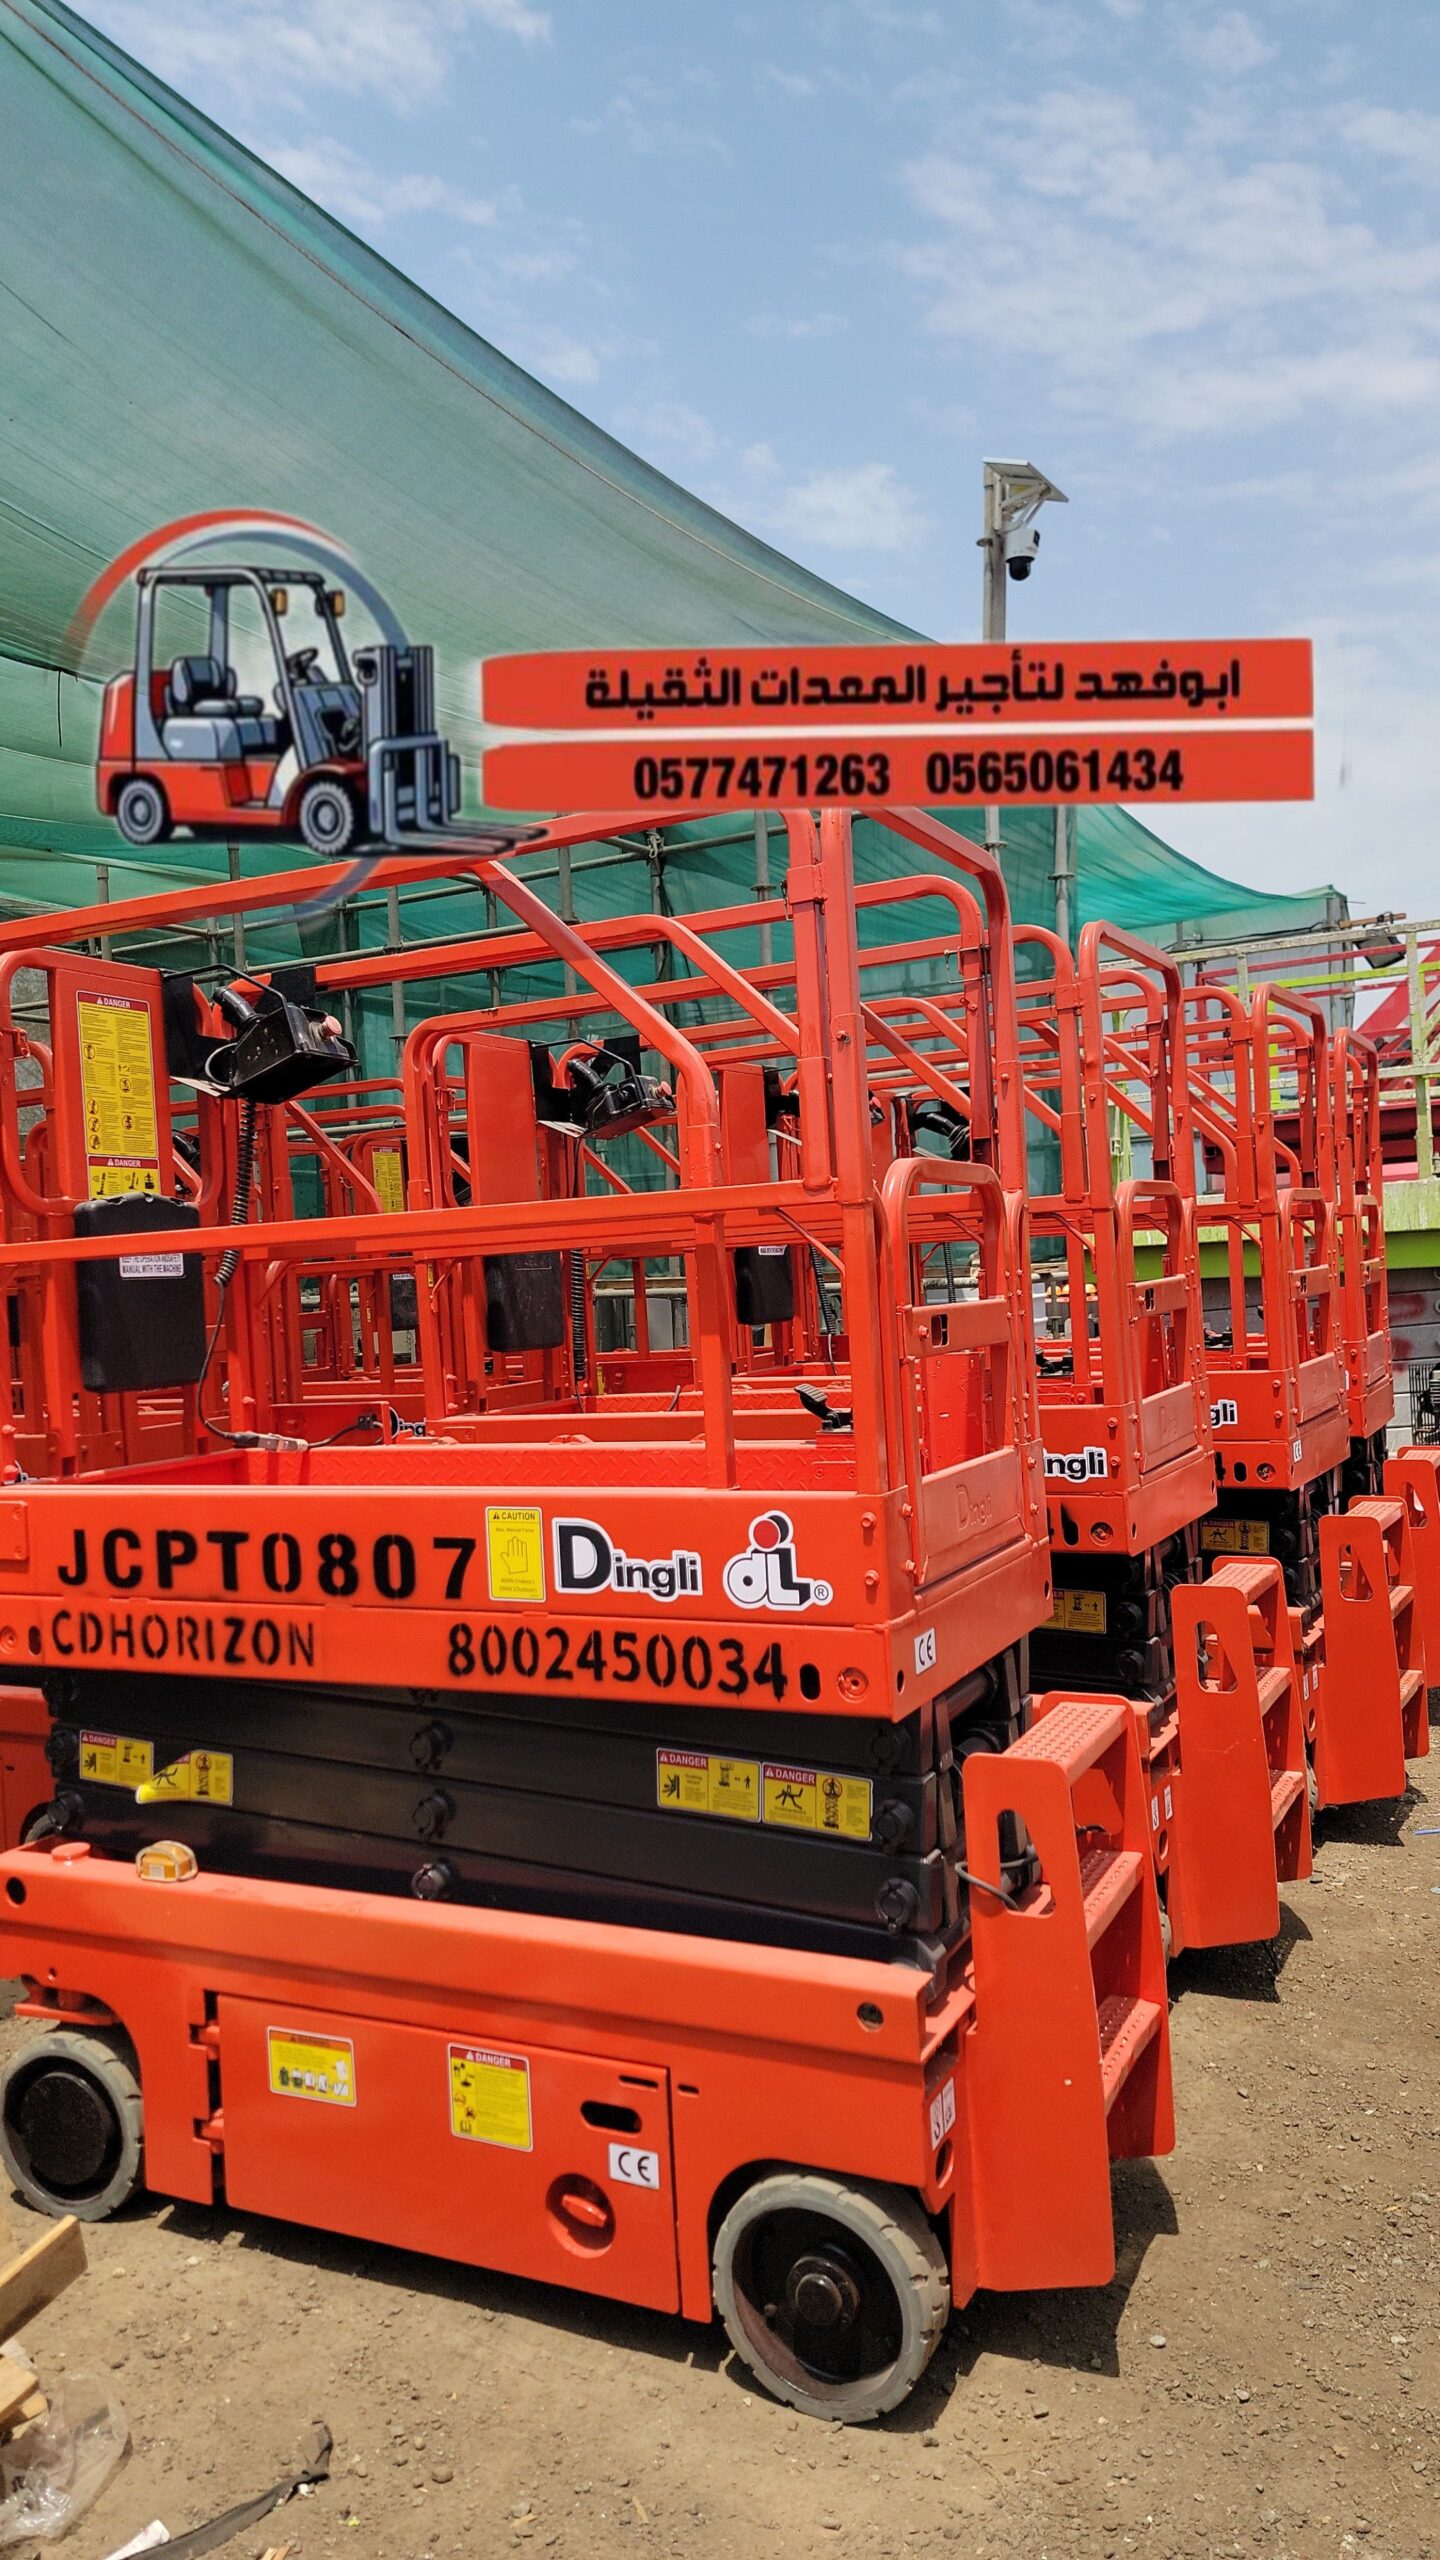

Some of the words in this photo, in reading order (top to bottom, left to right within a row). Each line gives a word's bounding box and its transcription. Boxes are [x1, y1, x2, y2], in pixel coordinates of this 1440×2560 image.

[103, 998, 131, 1008] DANGER
[114, 1159, 141, 1167] DANGER
[1045, 1450, 1105, 1480] ngli
[501, 1512, 535, 1520] CAUTION
[58, 1528, 476, 1600] JCPT0807
[556, 1521, 699, 1598] Dingli
[51, 1609, 315, 1667] CDHORIZON
[918, 1633, 933, 1666] CE
[447, 1622, 789, 1701] 8002450034
[89, 1733, 116, 1747] DANGER
[669, 1753, 707, 1768] DANGER
[775, 1768, 815, 1784] DANGER
[475, 2052, 511, 2068] DANGER
[617, 2151, 651, 2183] CE
